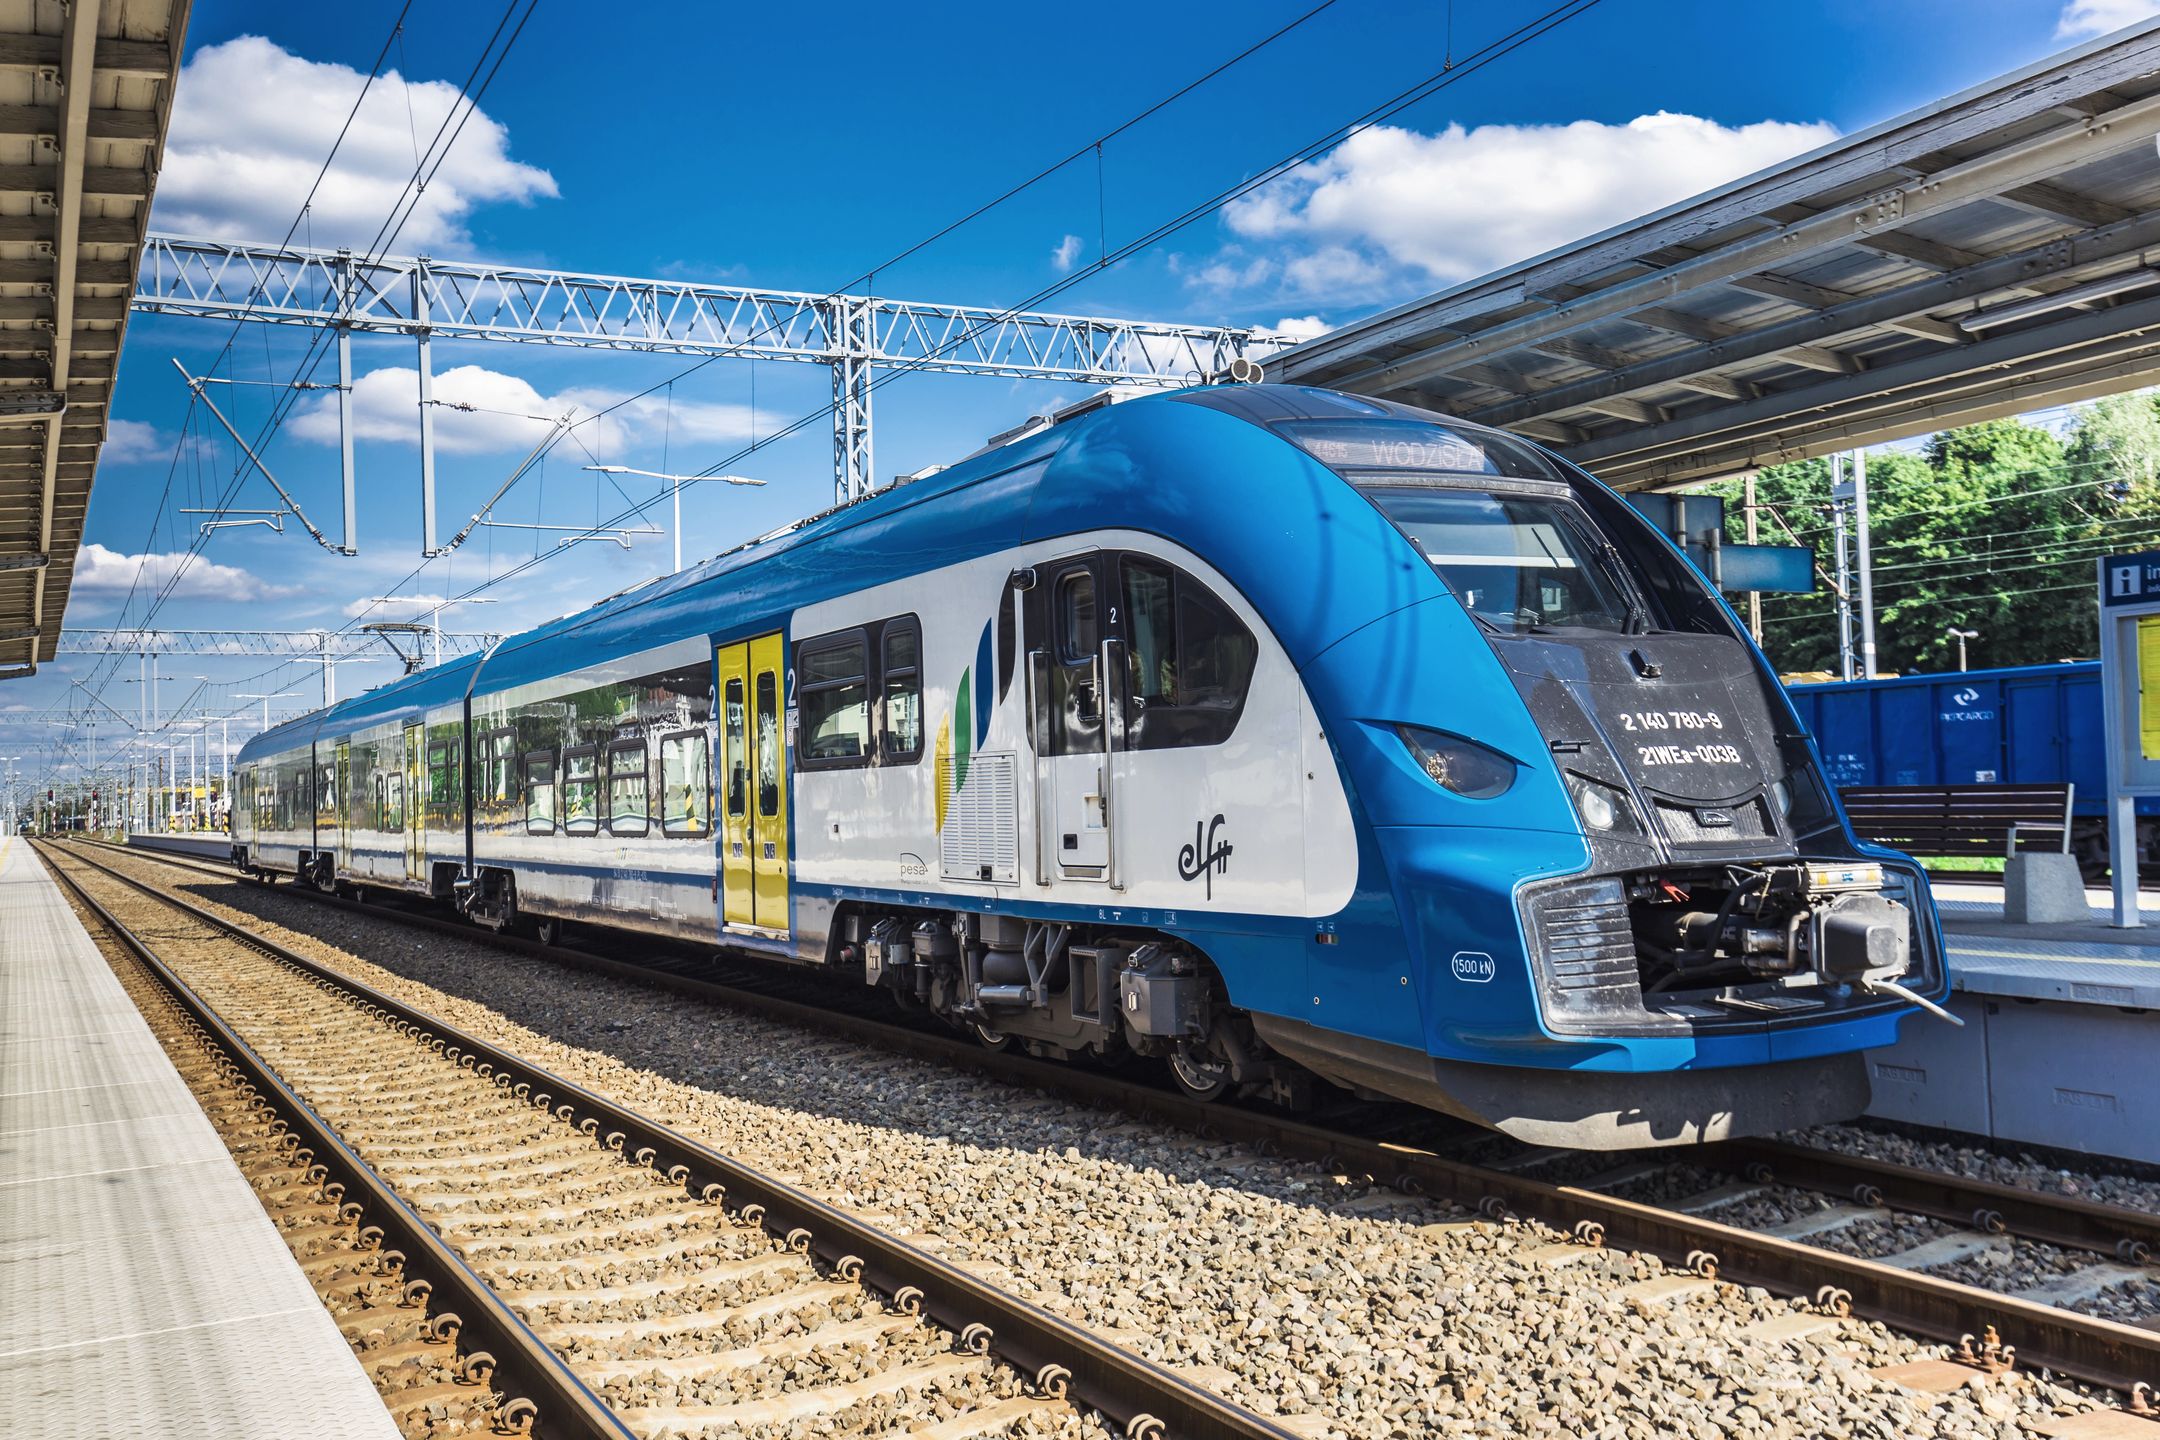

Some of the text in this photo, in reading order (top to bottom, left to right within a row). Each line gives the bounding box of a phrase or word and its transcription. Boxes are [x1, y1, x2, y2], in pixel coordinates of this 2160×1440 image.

[1110, 606, 1117, 624] 2
[787, 668, 797, 707] 2
[708, 684, 717, 719] 2
[1620, 711, 1723, 731] 2 140 780-9
[1638, 745, 1741, 766] 21WEa-003B
[1455, 959, 1492, 975] 1500 kN
